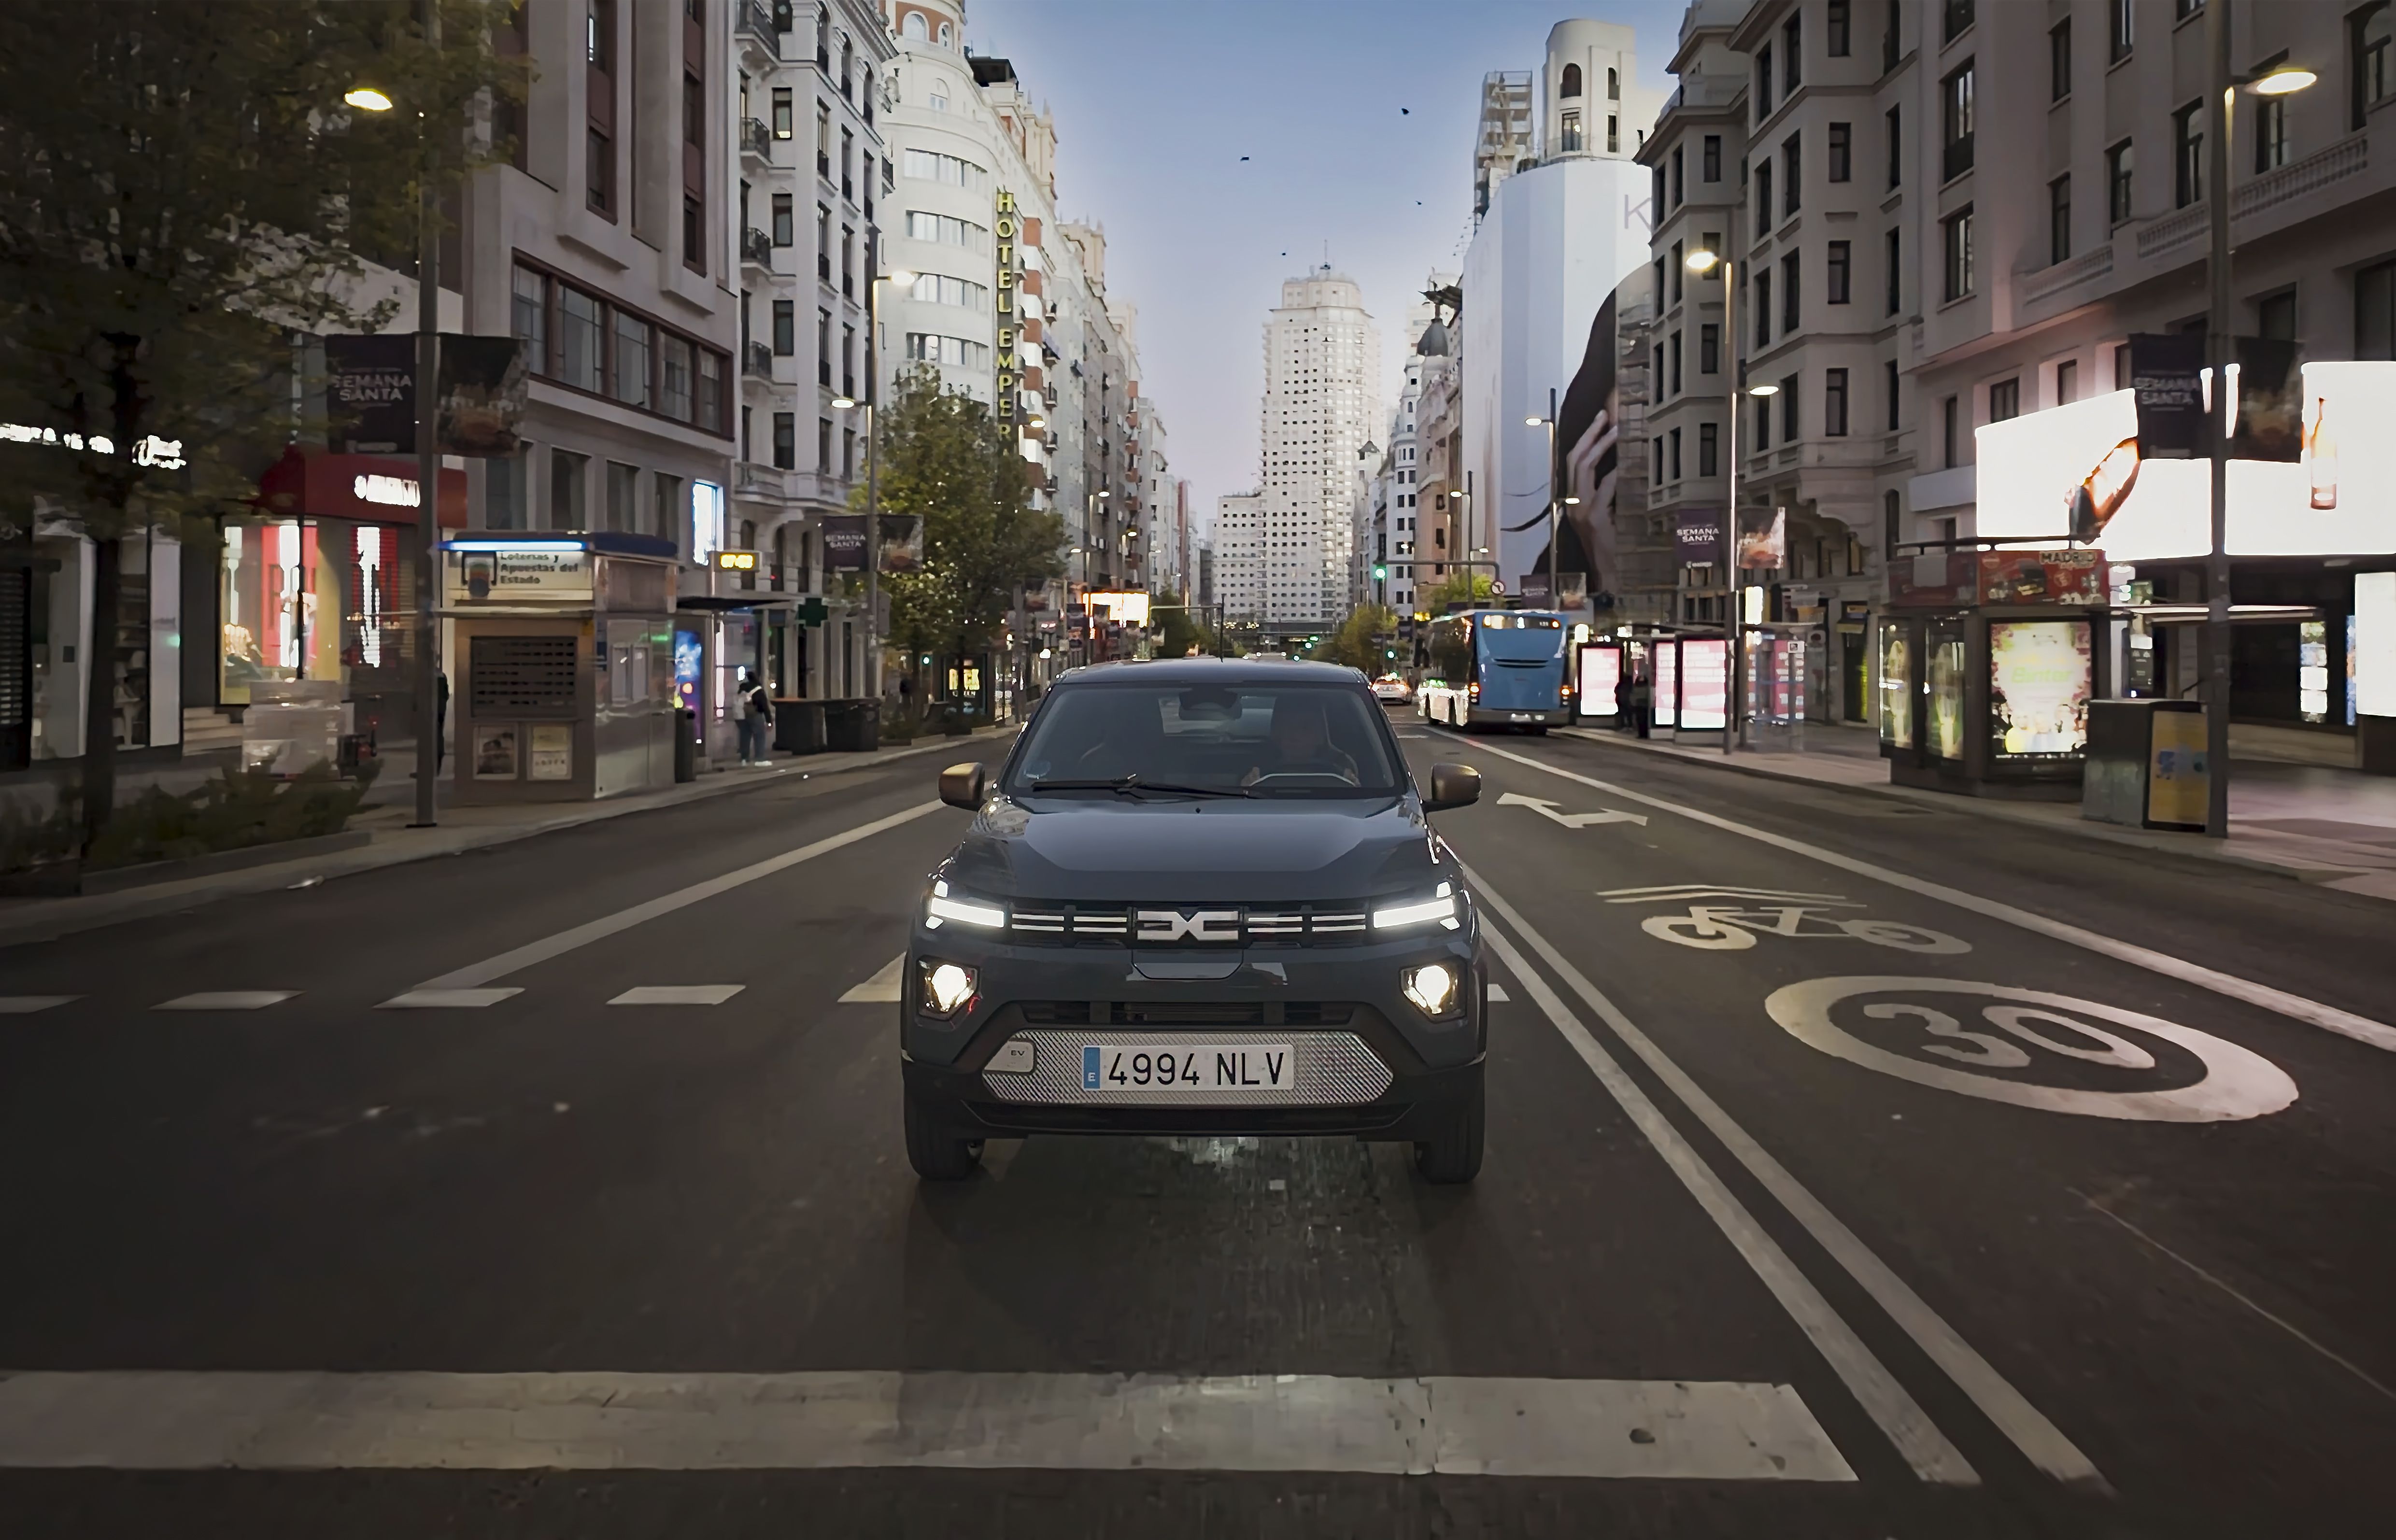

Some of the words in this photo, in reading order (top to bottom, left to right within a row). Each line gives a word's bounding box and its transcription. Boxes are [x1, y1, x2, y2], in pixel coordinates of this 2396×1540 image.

[996, 192, 1013, 313] HOTEL
[333, 374, 412, 388] SEMANA
[340, 388, 403, 401] SANTA
[2141, 392, 2194, 405] SANTA
[1864, 1003, 2155, 1068] 30
[1108, 1053, 1200, 1086] 4994
[1217, 1053, 1284, 1086] NLV
[1088, 1073, 1095, 1082] E
